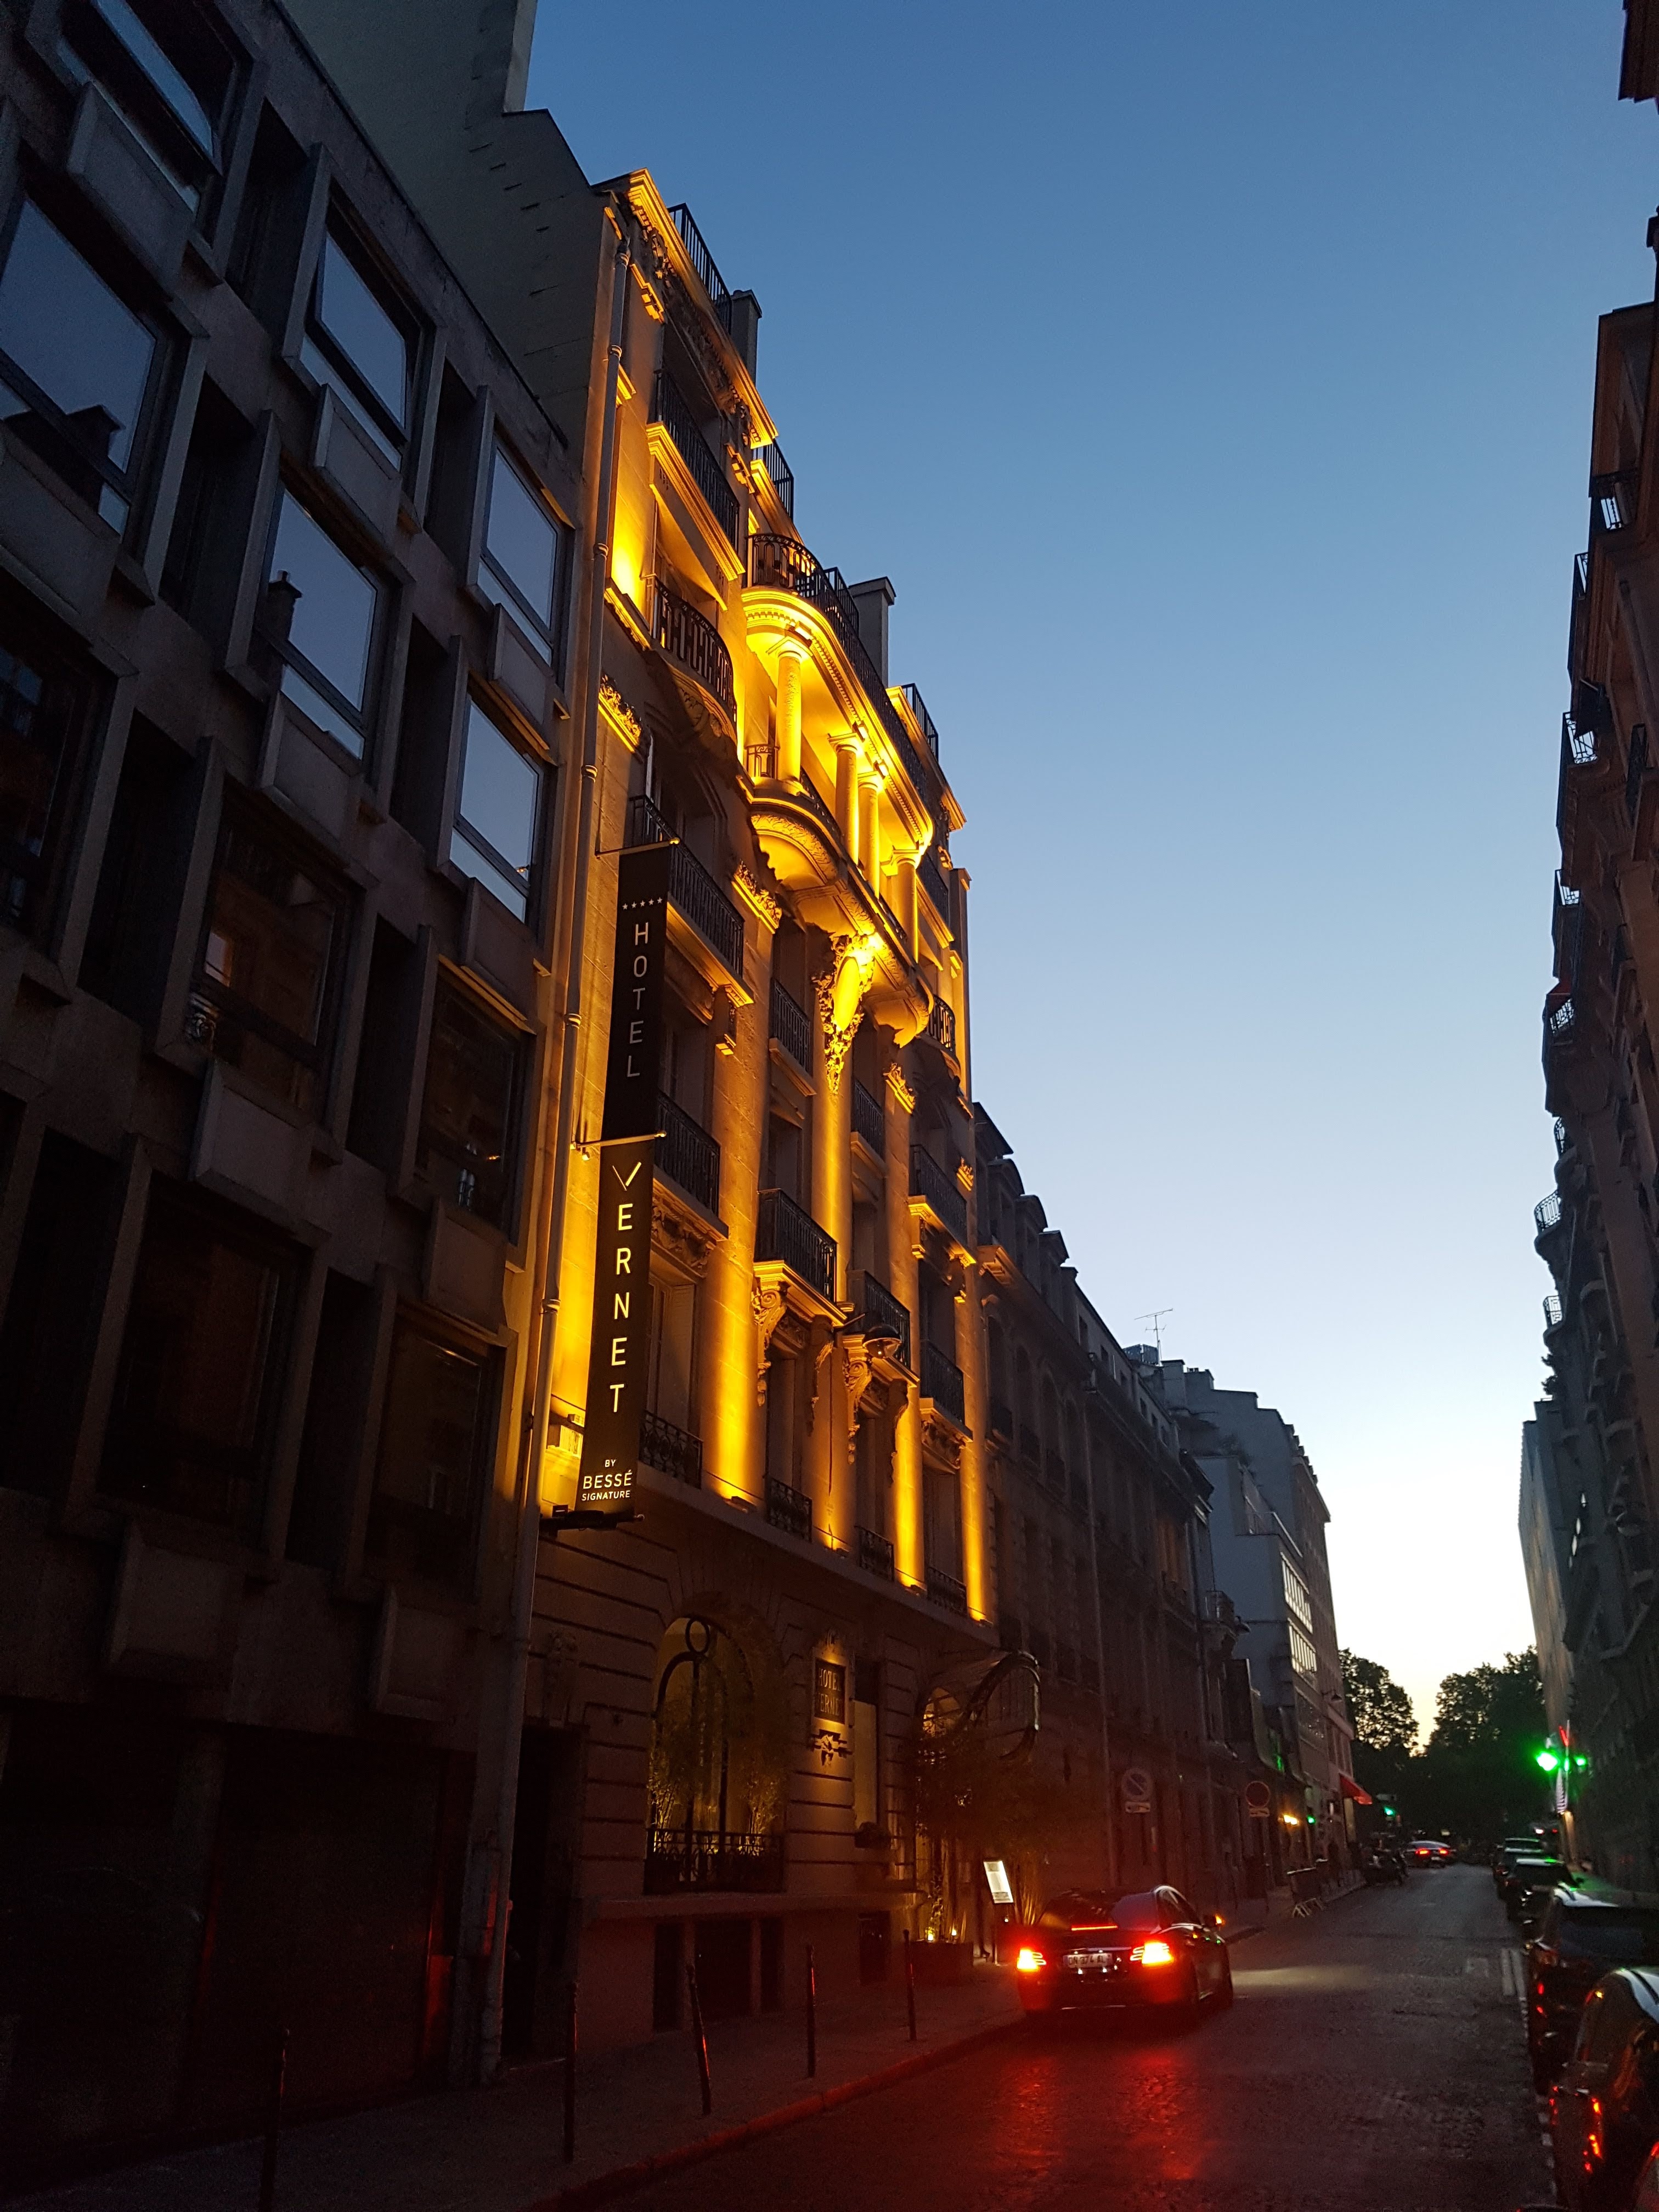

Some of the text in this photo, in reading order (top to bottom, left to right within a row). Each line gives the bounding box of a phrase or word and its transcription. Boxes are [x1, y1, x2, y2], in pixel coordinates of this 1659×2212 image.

[627, 922, 649, 1077] HOTEL
[610, 1161, 642, 1413] VERNET
[605, 1459, 616, 1468] BY
[583, 1469, 633, 1489] BESSÉ
[582, 1490, 631, 1501] SIGNATURE
[818, 1668, 842, 1691] HOTEL
[817, 1692, 843, 1716] ERNE
